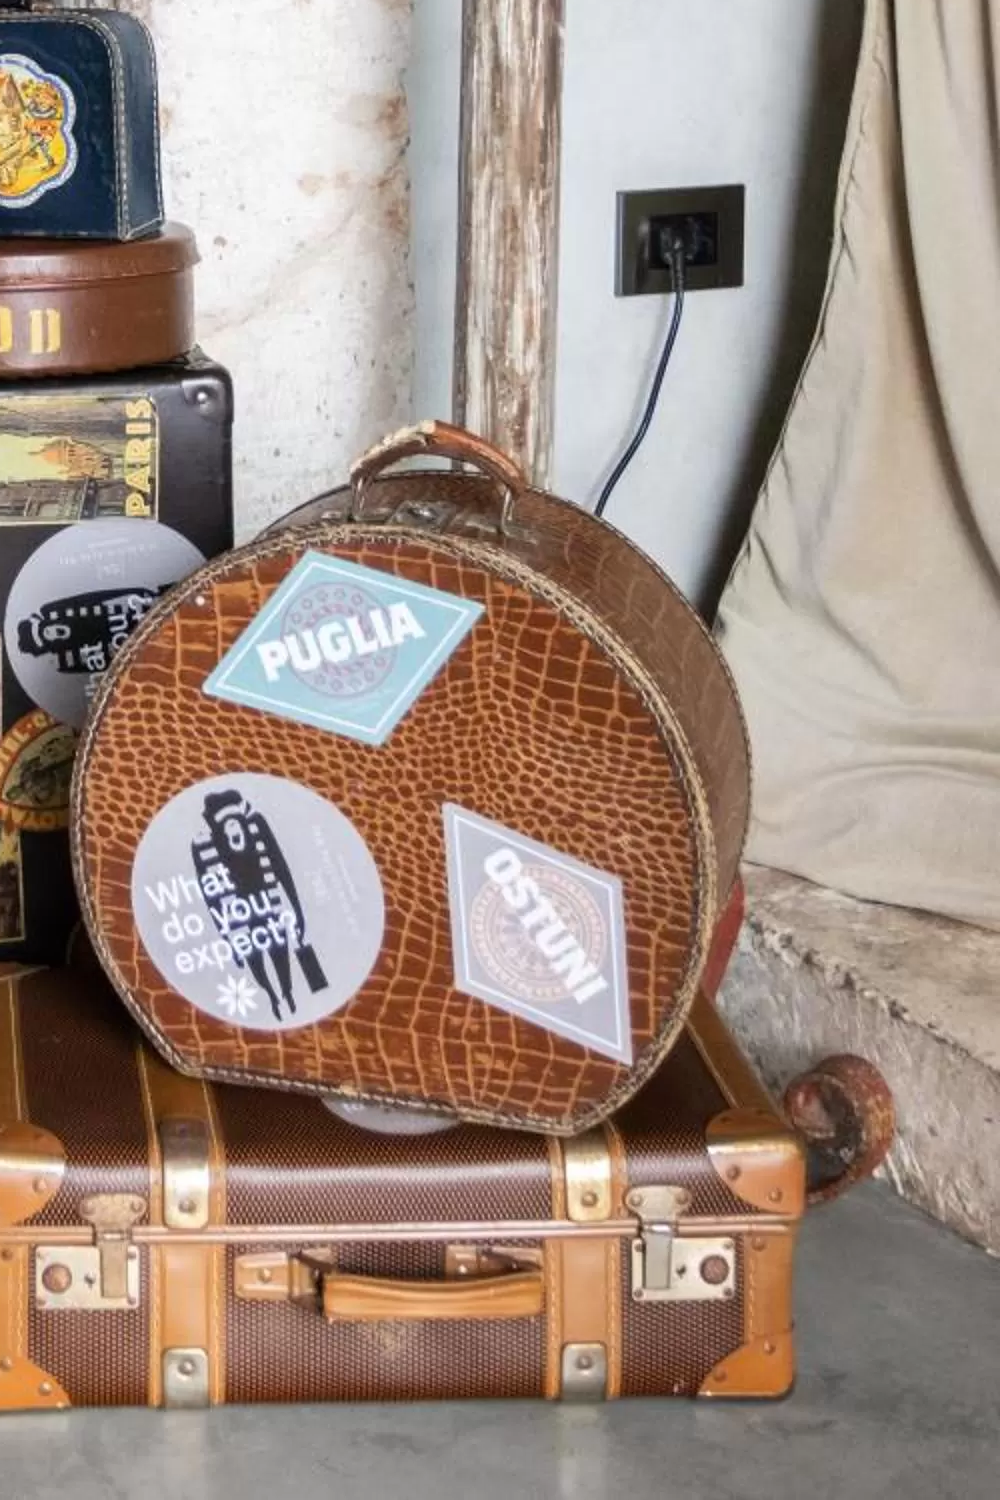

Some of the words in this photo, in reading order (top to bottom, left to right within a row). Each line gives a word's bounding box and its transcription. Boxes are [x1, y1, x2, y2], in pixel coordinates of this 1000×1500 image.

[124, 397, 153, 517] PARIS
[255, 601, 428, 683] PUGLIA
[145, 862, 236, 913] What
[162, 911, 204, 944] do
[210, 890, 274, 932] you
[175, 911, 298, 975] expect?
[483, 846, 610, 1005] OSTUNI
